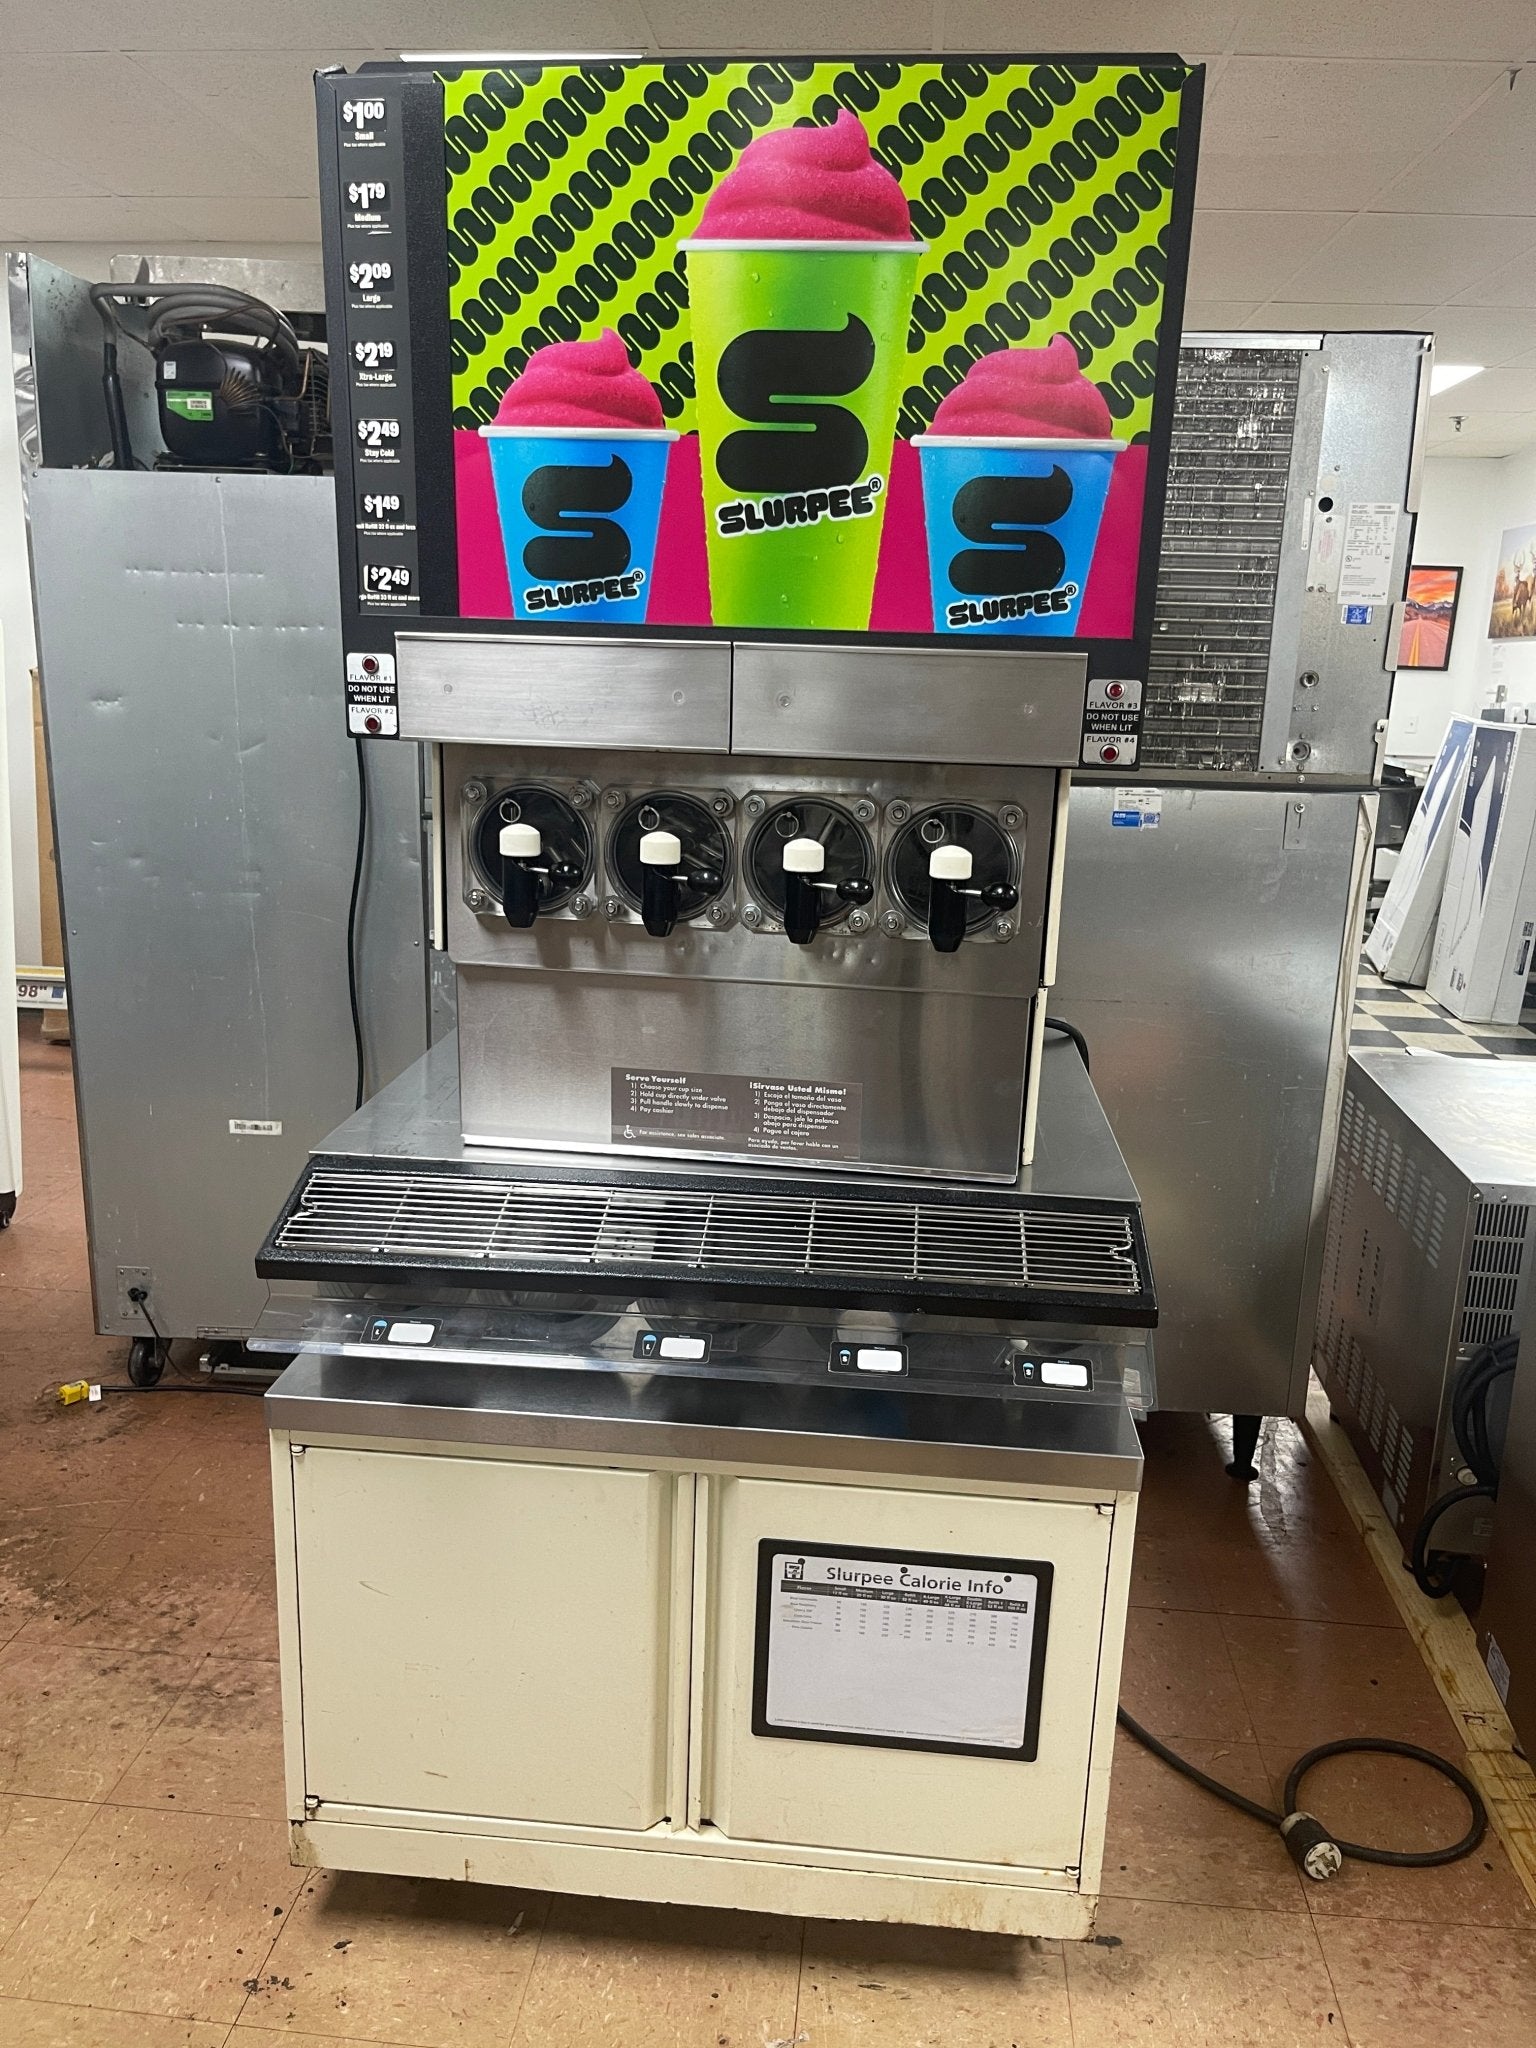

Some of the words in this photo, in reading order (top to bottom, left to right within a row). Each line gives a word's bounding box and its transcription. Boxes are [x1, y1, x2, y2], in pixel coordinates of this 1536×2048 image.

[362, 294, 381, 303] Large
[1090, 701, 1124, 709] FLAVOR
[1091, 723, 1117, 731] WHEN
[626, 1074, 649, 1082] Serve
[651, 1076, 686, 1084] Yourself
[788, 1084, 812, 1093] Usted
[814, 1086, 847, 1095] Mismo!
[668, 1092, 689, 1101] directly
[764, 1092, 783, 1100] Escoja
[640, 1106, 651, 1114] Pay
[652, 1099, 673, 1107] handle
[674, 1101, 693, 1109] slowly
[702, 1102, 729, 1111] dispense
[764, 1099, 783, 1107] Ponga
[808, 1102, 847, 1111] directamente
[764, 1105, 785, 1114] debajo
[797, 1108, 835, 1116] dispensador
[764, 1113, 793, 1121] Despacio,
[794, 1115, 805, 1123] jale
[814, 1117, 839, 1125] palanca
[763, 1120, 781, 1128] abajo
[798, 1122, 828, 1130] dispensar
[763, 1127, 782, 1135] Pague
[826, 1567, 893, 1586] Slurpee
[900, 1574, 962, 1591] Calorie
[968, 1580, 1004, 1594] Info
